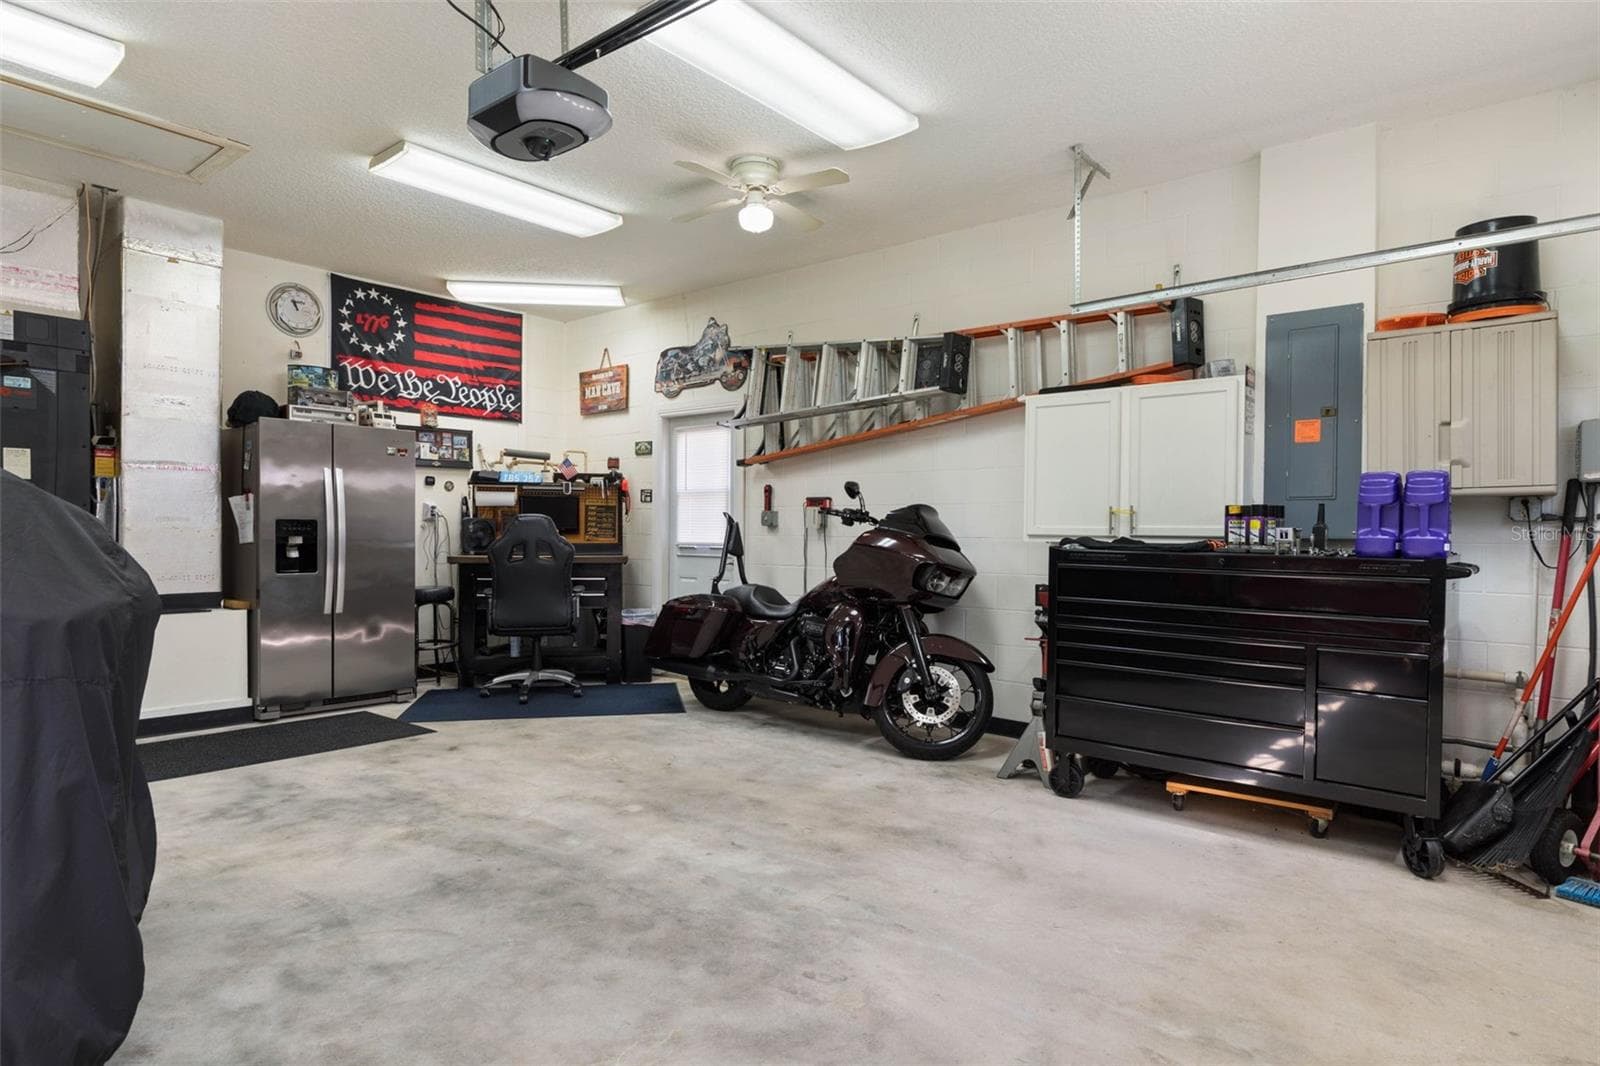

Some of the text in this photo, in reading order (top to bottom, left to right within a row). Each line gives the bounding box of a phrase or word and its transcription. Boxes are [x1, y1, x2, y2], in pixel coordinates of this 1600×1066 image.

[340, 359, 393, 395] We
[432, 374, 521, 415] People
[584, 381, 621, 399] MAN CAVE
